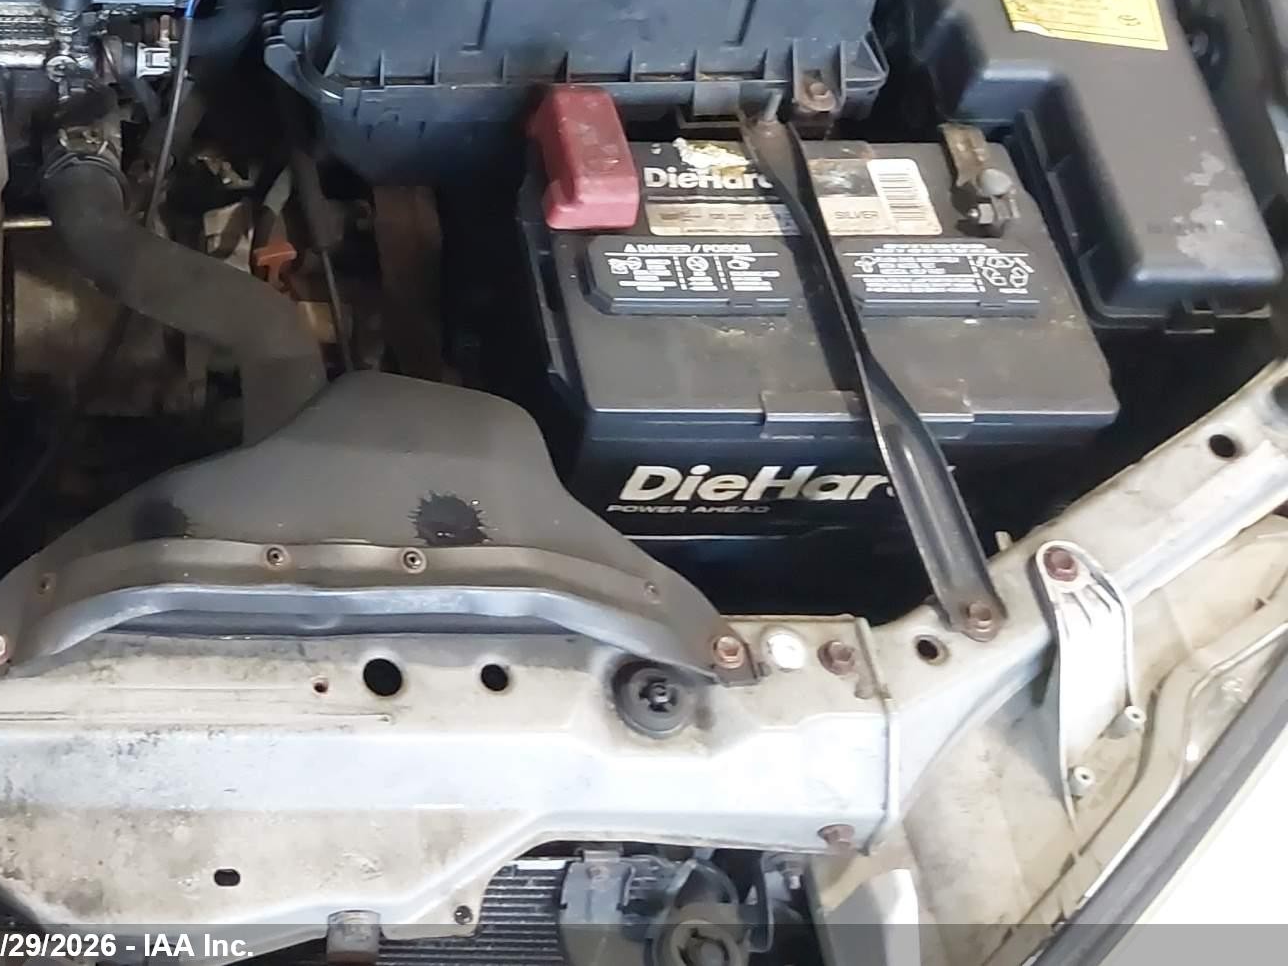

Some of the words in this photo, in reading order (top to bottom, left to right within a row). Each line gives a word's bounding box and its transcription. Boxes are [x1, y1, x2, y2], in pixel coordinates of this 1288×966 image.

[618, 464, 896, 501] DieHar
[606, 504, 687, 513] POWER
[691, 504, 771, 513] AHEAD
